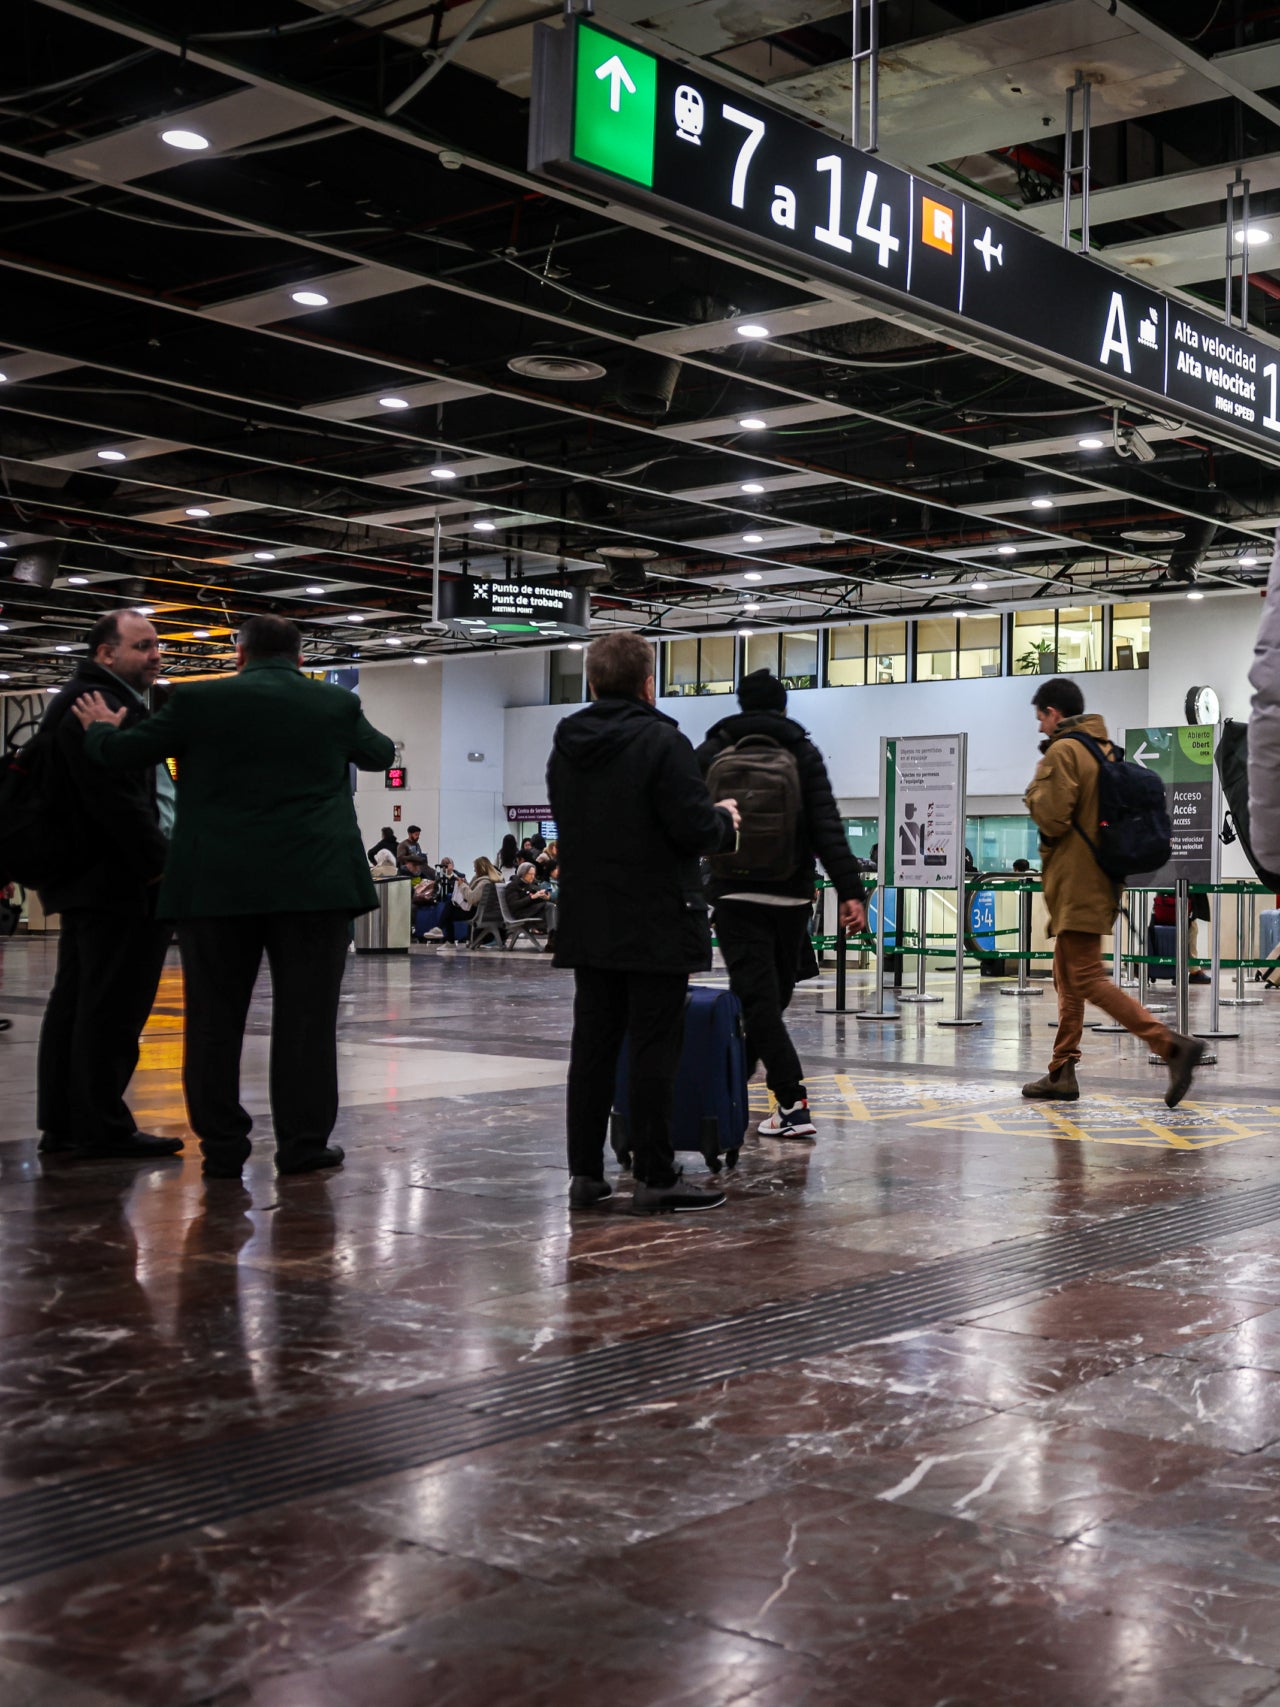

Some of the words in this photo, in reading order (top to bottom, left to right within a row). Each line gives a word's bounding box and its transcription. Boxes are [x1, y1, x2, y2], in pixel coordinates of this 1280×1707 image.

[722, 103, 766, 209] 7
[771, 184, 796, 230] a
[814, 154, 900, 268] 14
[933, 208, 953, 243] R
[1100, 291, 1132, 374] A
[1174, 320, 1199, 349] Alta
[1201, 335, 1256, 373] velocidad
[1176, 350, 1202, 379] Alta
[1205, 367, 1256, 401] velocitat
[1215, 395, 1233, 413] HIGH
[1234, 403, 1255, 423] SPEED
[492, 583, 519, 593] Punto
[521, 585, 533, 594] de
[534, 587, 573, 599] encuentro
[492, 595, 514, 604] Punt
[516, 596, 528, 605] de
[530, 597, 563, 609] trobada
[1188, 731, 1210, 739] Abierto
[1192, 741, 1210, 749] Obert
[1174, 791, 1202, 801] Acceso
[1174, 804, 1197, 815] Accés
